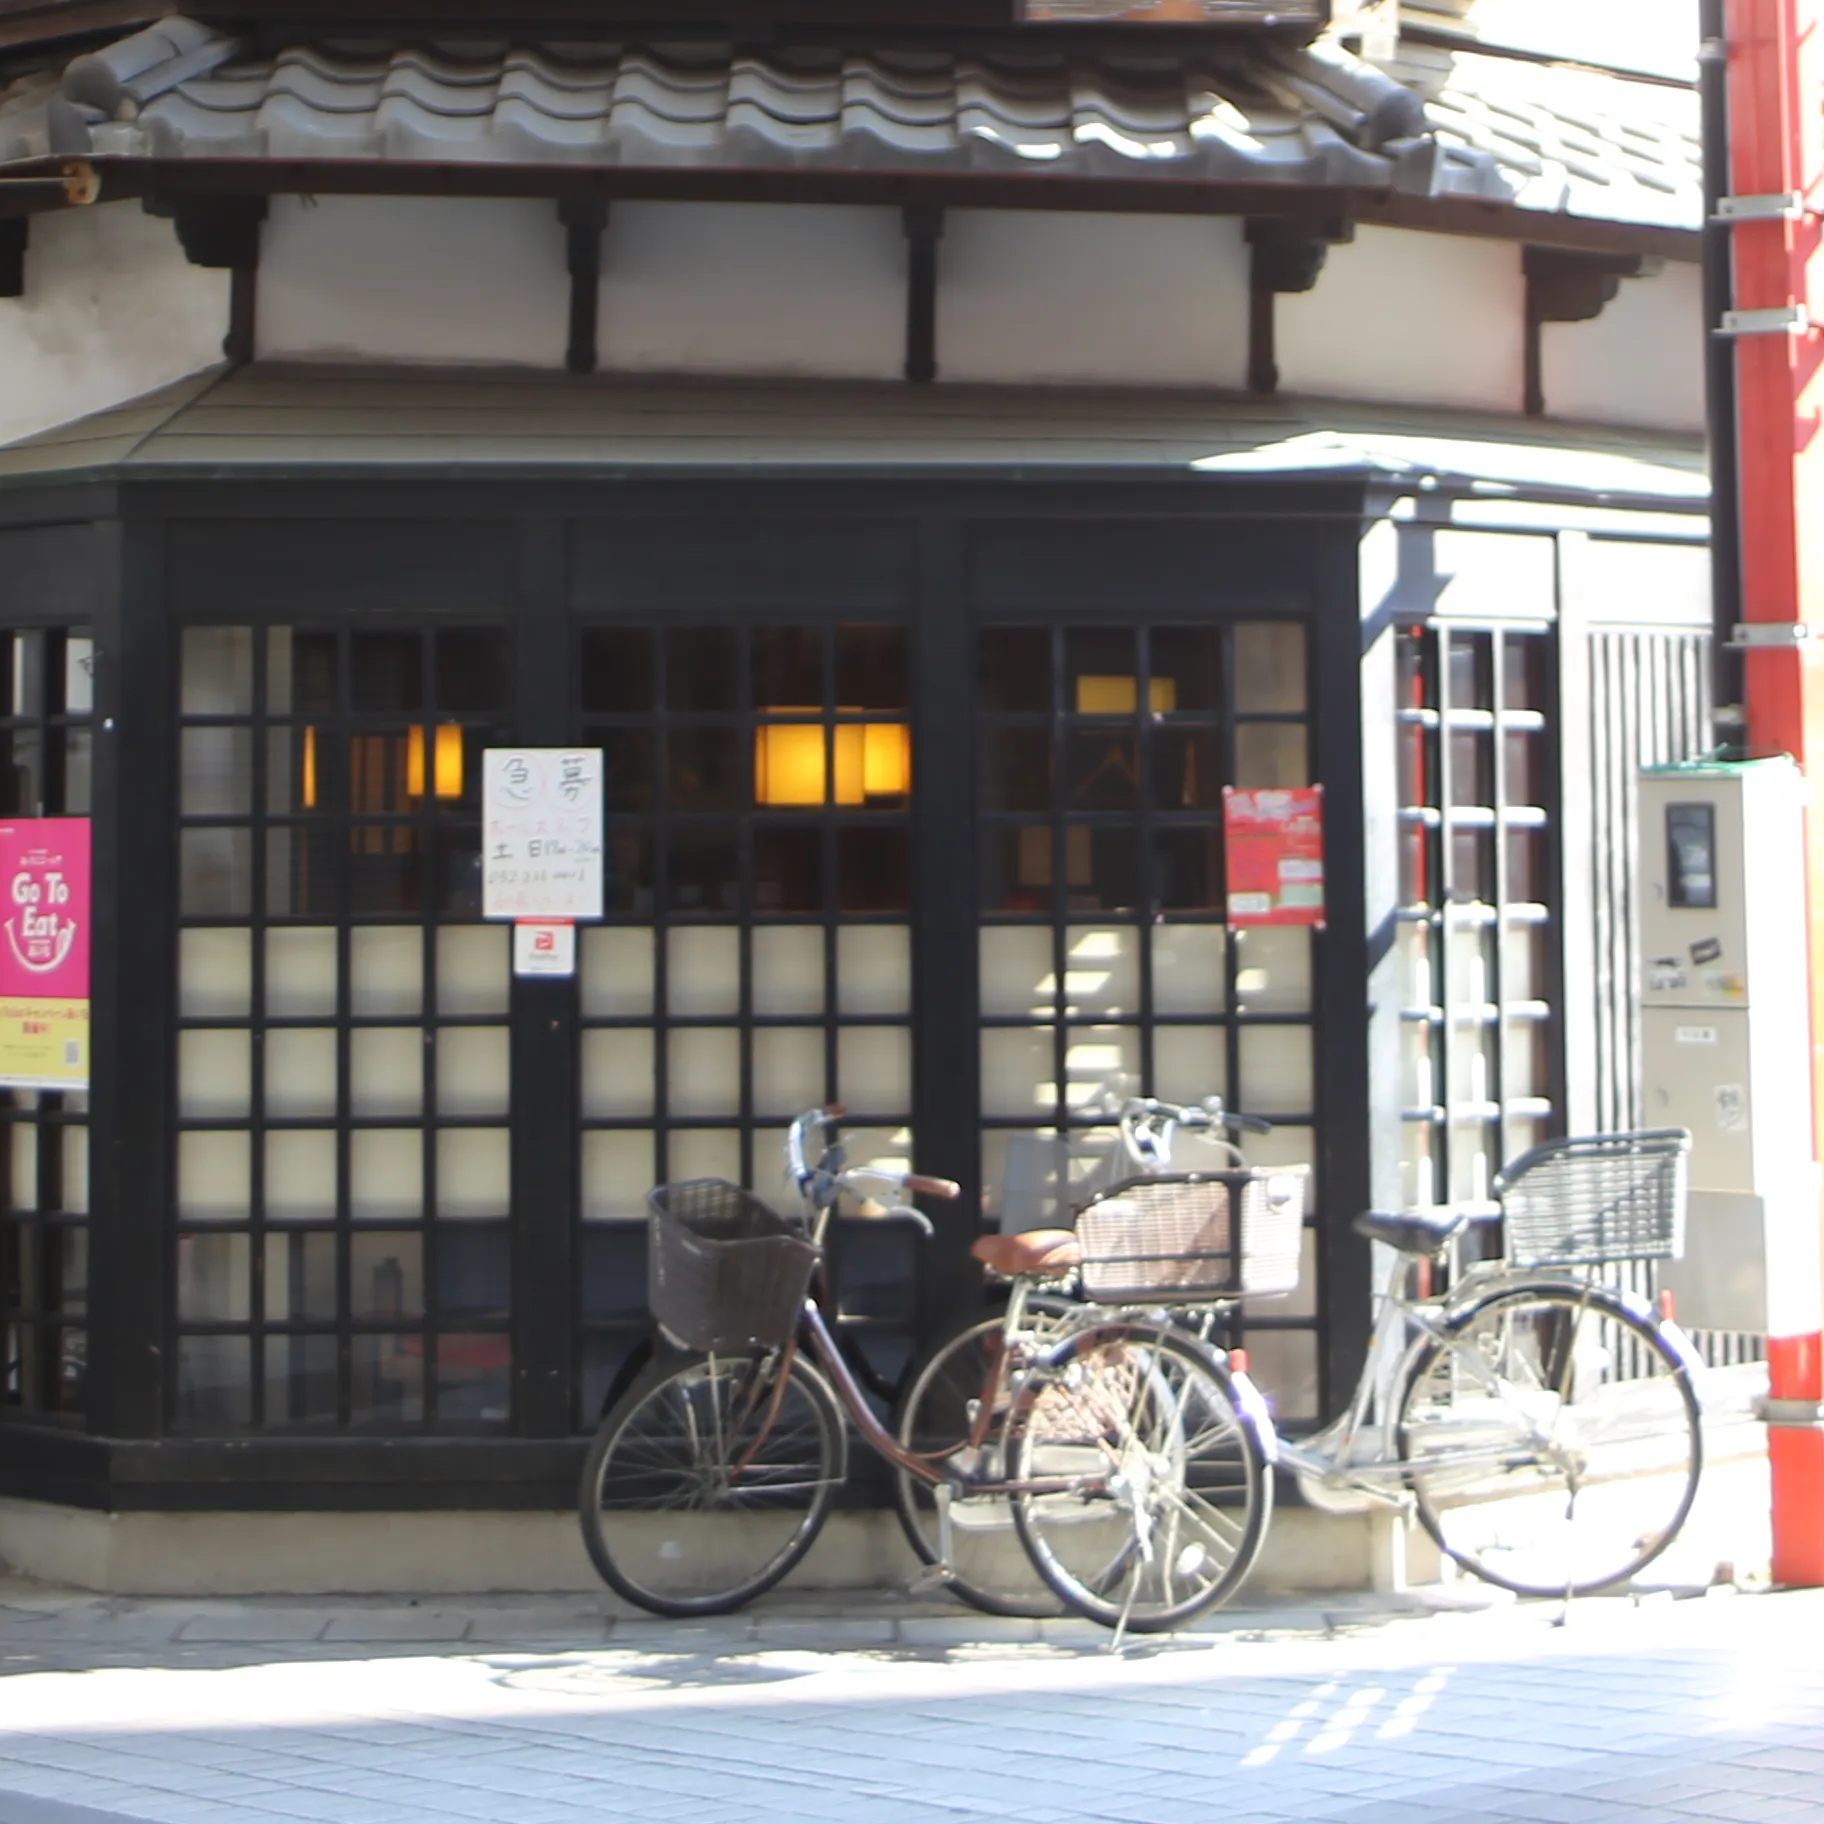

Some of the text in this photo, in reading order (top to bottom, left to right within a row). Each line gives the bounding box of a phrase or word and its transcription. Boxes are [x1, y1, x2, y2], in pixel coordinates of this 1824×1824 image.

[502, 757, 592, 802] 急募
[12, 872, 69, 905] Go To
[22, 906, 58, 937] Eat
